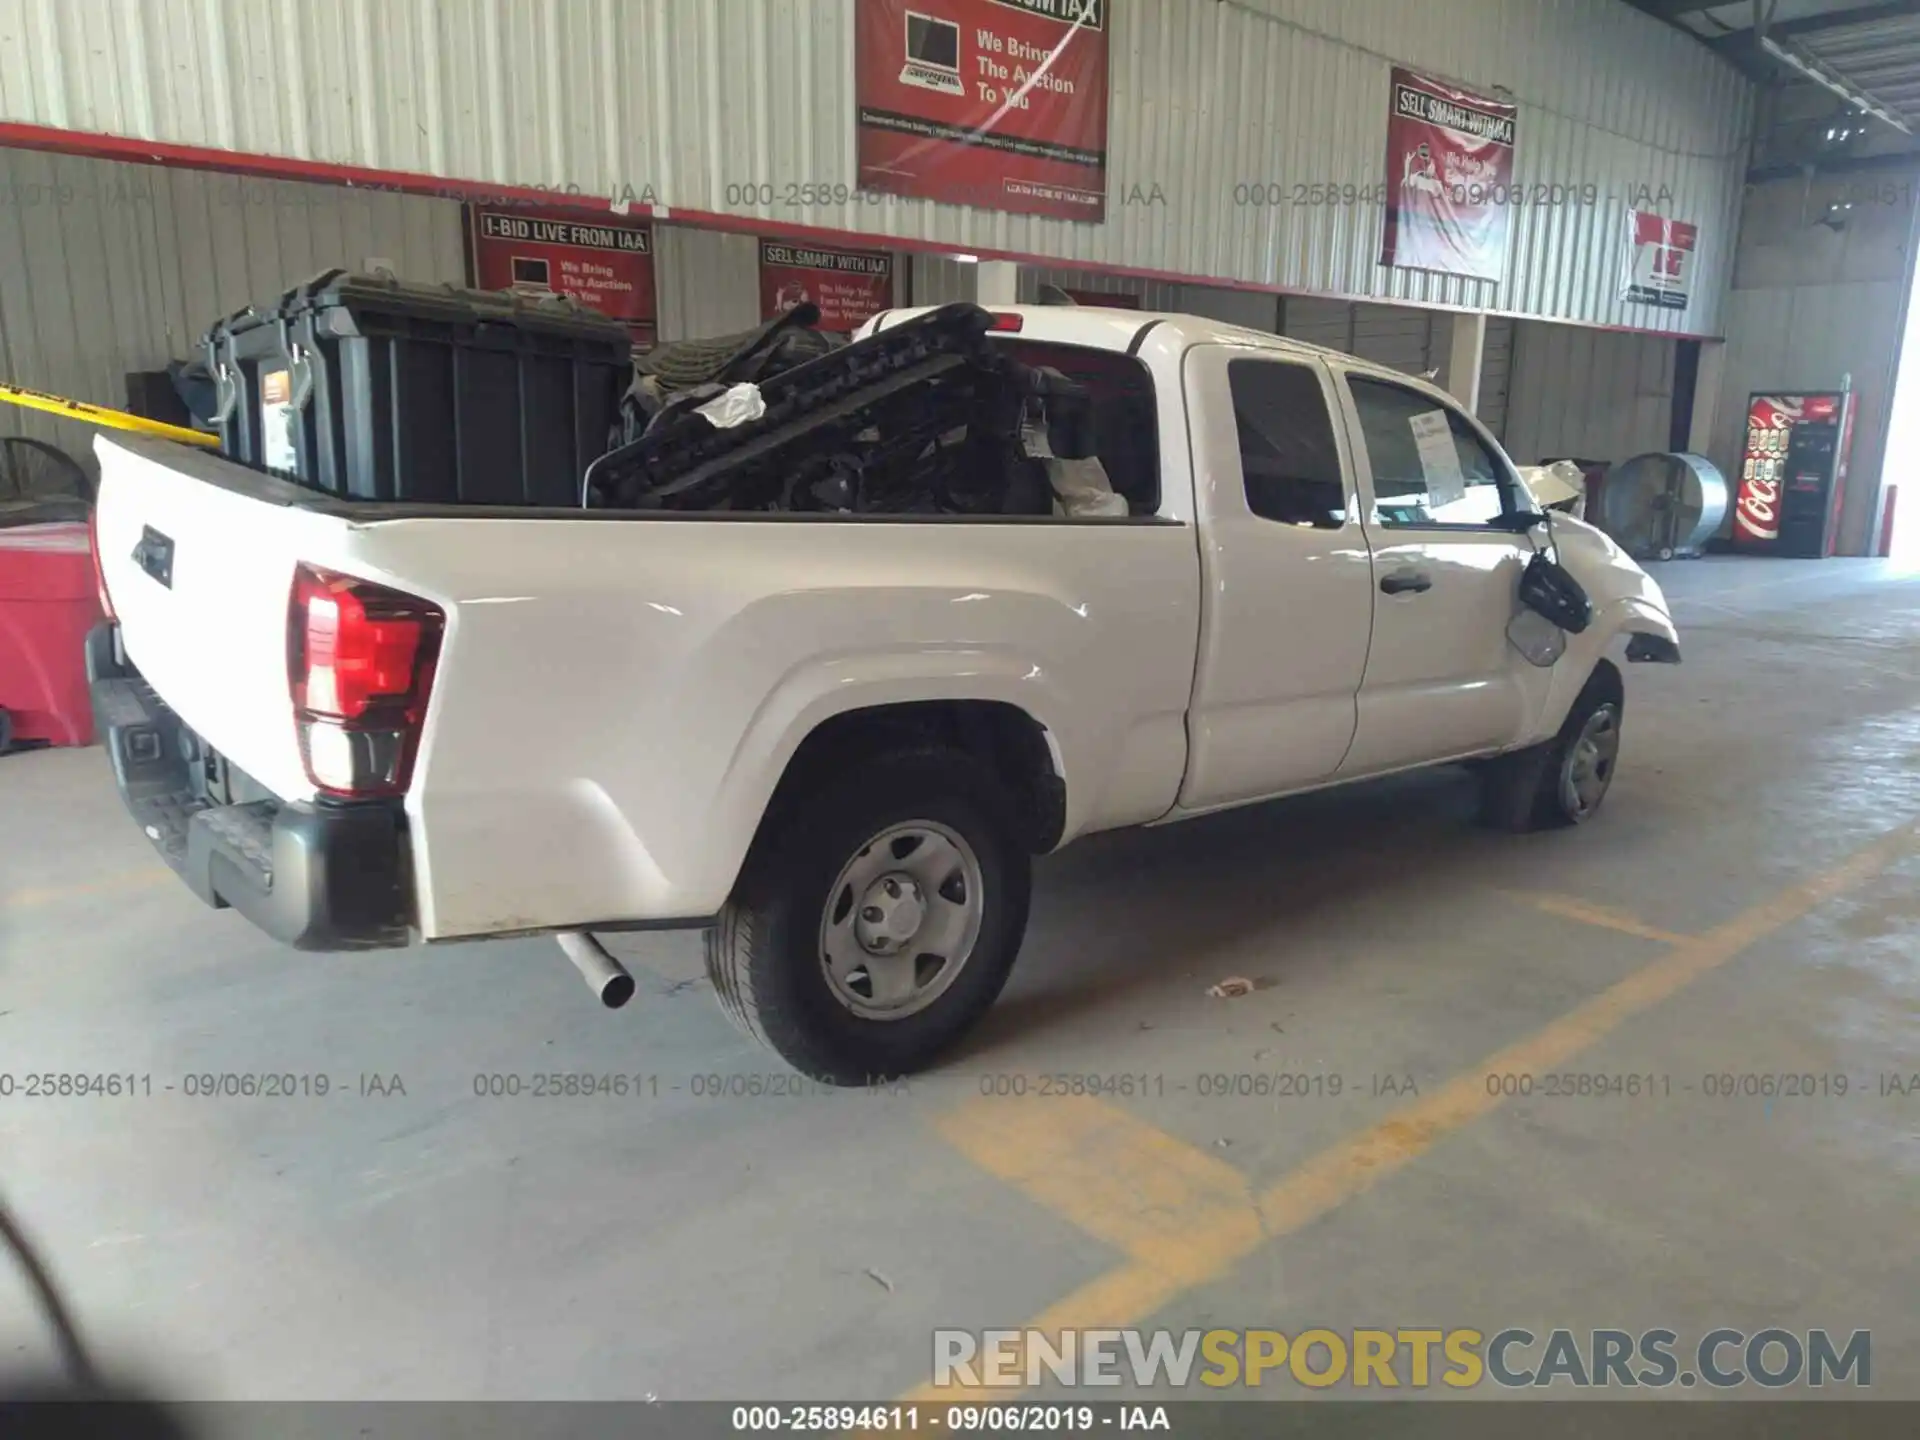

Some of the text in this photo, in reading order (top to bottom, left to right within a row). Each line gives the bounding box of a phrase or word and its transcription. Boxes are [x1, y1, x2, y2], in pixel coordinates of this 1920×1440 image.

[976, 28, 1053, 62] We Bring
[976, 55, 1008, 79] The
[976, 81, 997, 103] To
[1400, 91, 1426, 117] SELL
[1428, 99, 1466, 127] SMART
[487, 217, 645, 250] I-BID LIVE FROM IAA
[561, 260, 613, 276] We Bring
[767, 247, 886, 273] SELL SMART WITH IAA
[561, 274, 632, 291] The Auction
